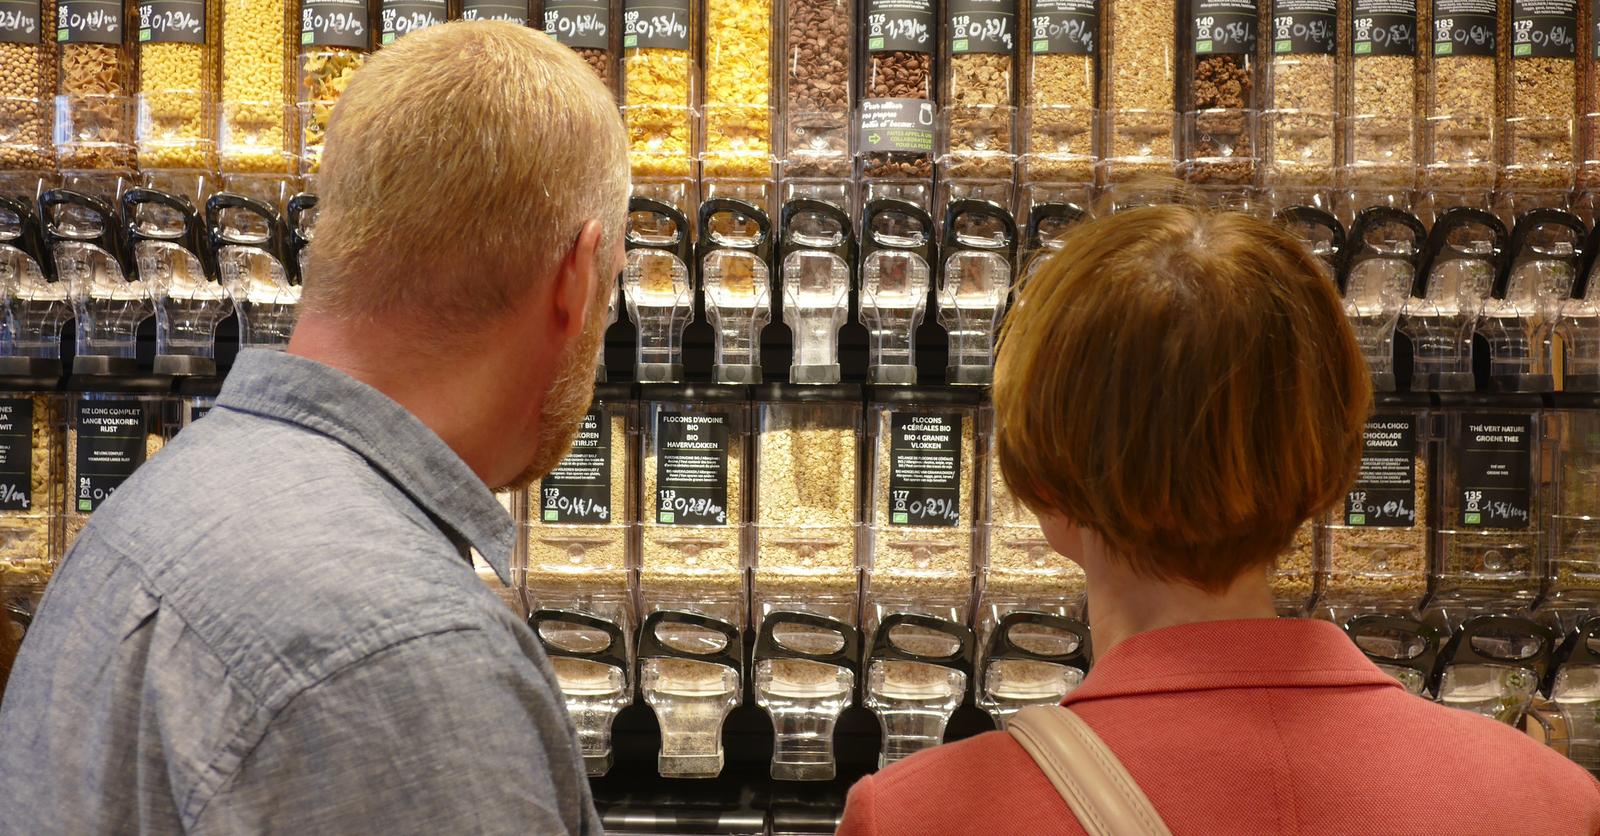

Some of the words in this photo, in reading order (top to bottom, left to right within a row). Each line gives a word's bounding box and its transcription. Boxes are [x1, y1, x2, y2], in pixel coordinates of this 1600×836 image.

[140, 5, 152, 16] 115
[382, 9, 396, 20] 174
[464, 10, 478, 20] 117
[544, 10, 559, 20] 116
[624, 11, 639, 21] 109
[869, 14, 886, 24] 176
[952, 16, 970, 26] 118
[1032, 16, 1050, 26] 122
[1196, 16, 1214, 26] 140
[1274, 16, 1293, 26] 178
[1354, 18, 1373, 28] 182
[1434, 18, 1454, 29] 183
[1514, 20, 1533, 30] 179
[102, 418, 139, 426] VOLKOREN
[1387, 422, 1409, 430] CHOCO
[907, 424, 939, 432] CÉRÉALES
[1470, 424, 1483, 432] THÉ
[80, 477, 90, 486] 94
[544, 488, 560, 497] 173
[660, 490, 676, 499] 113
[893, 490, 909, 499] 177
[1349, 492, 1367, 501] 112
[1464, 491, 1482, 500] 135
